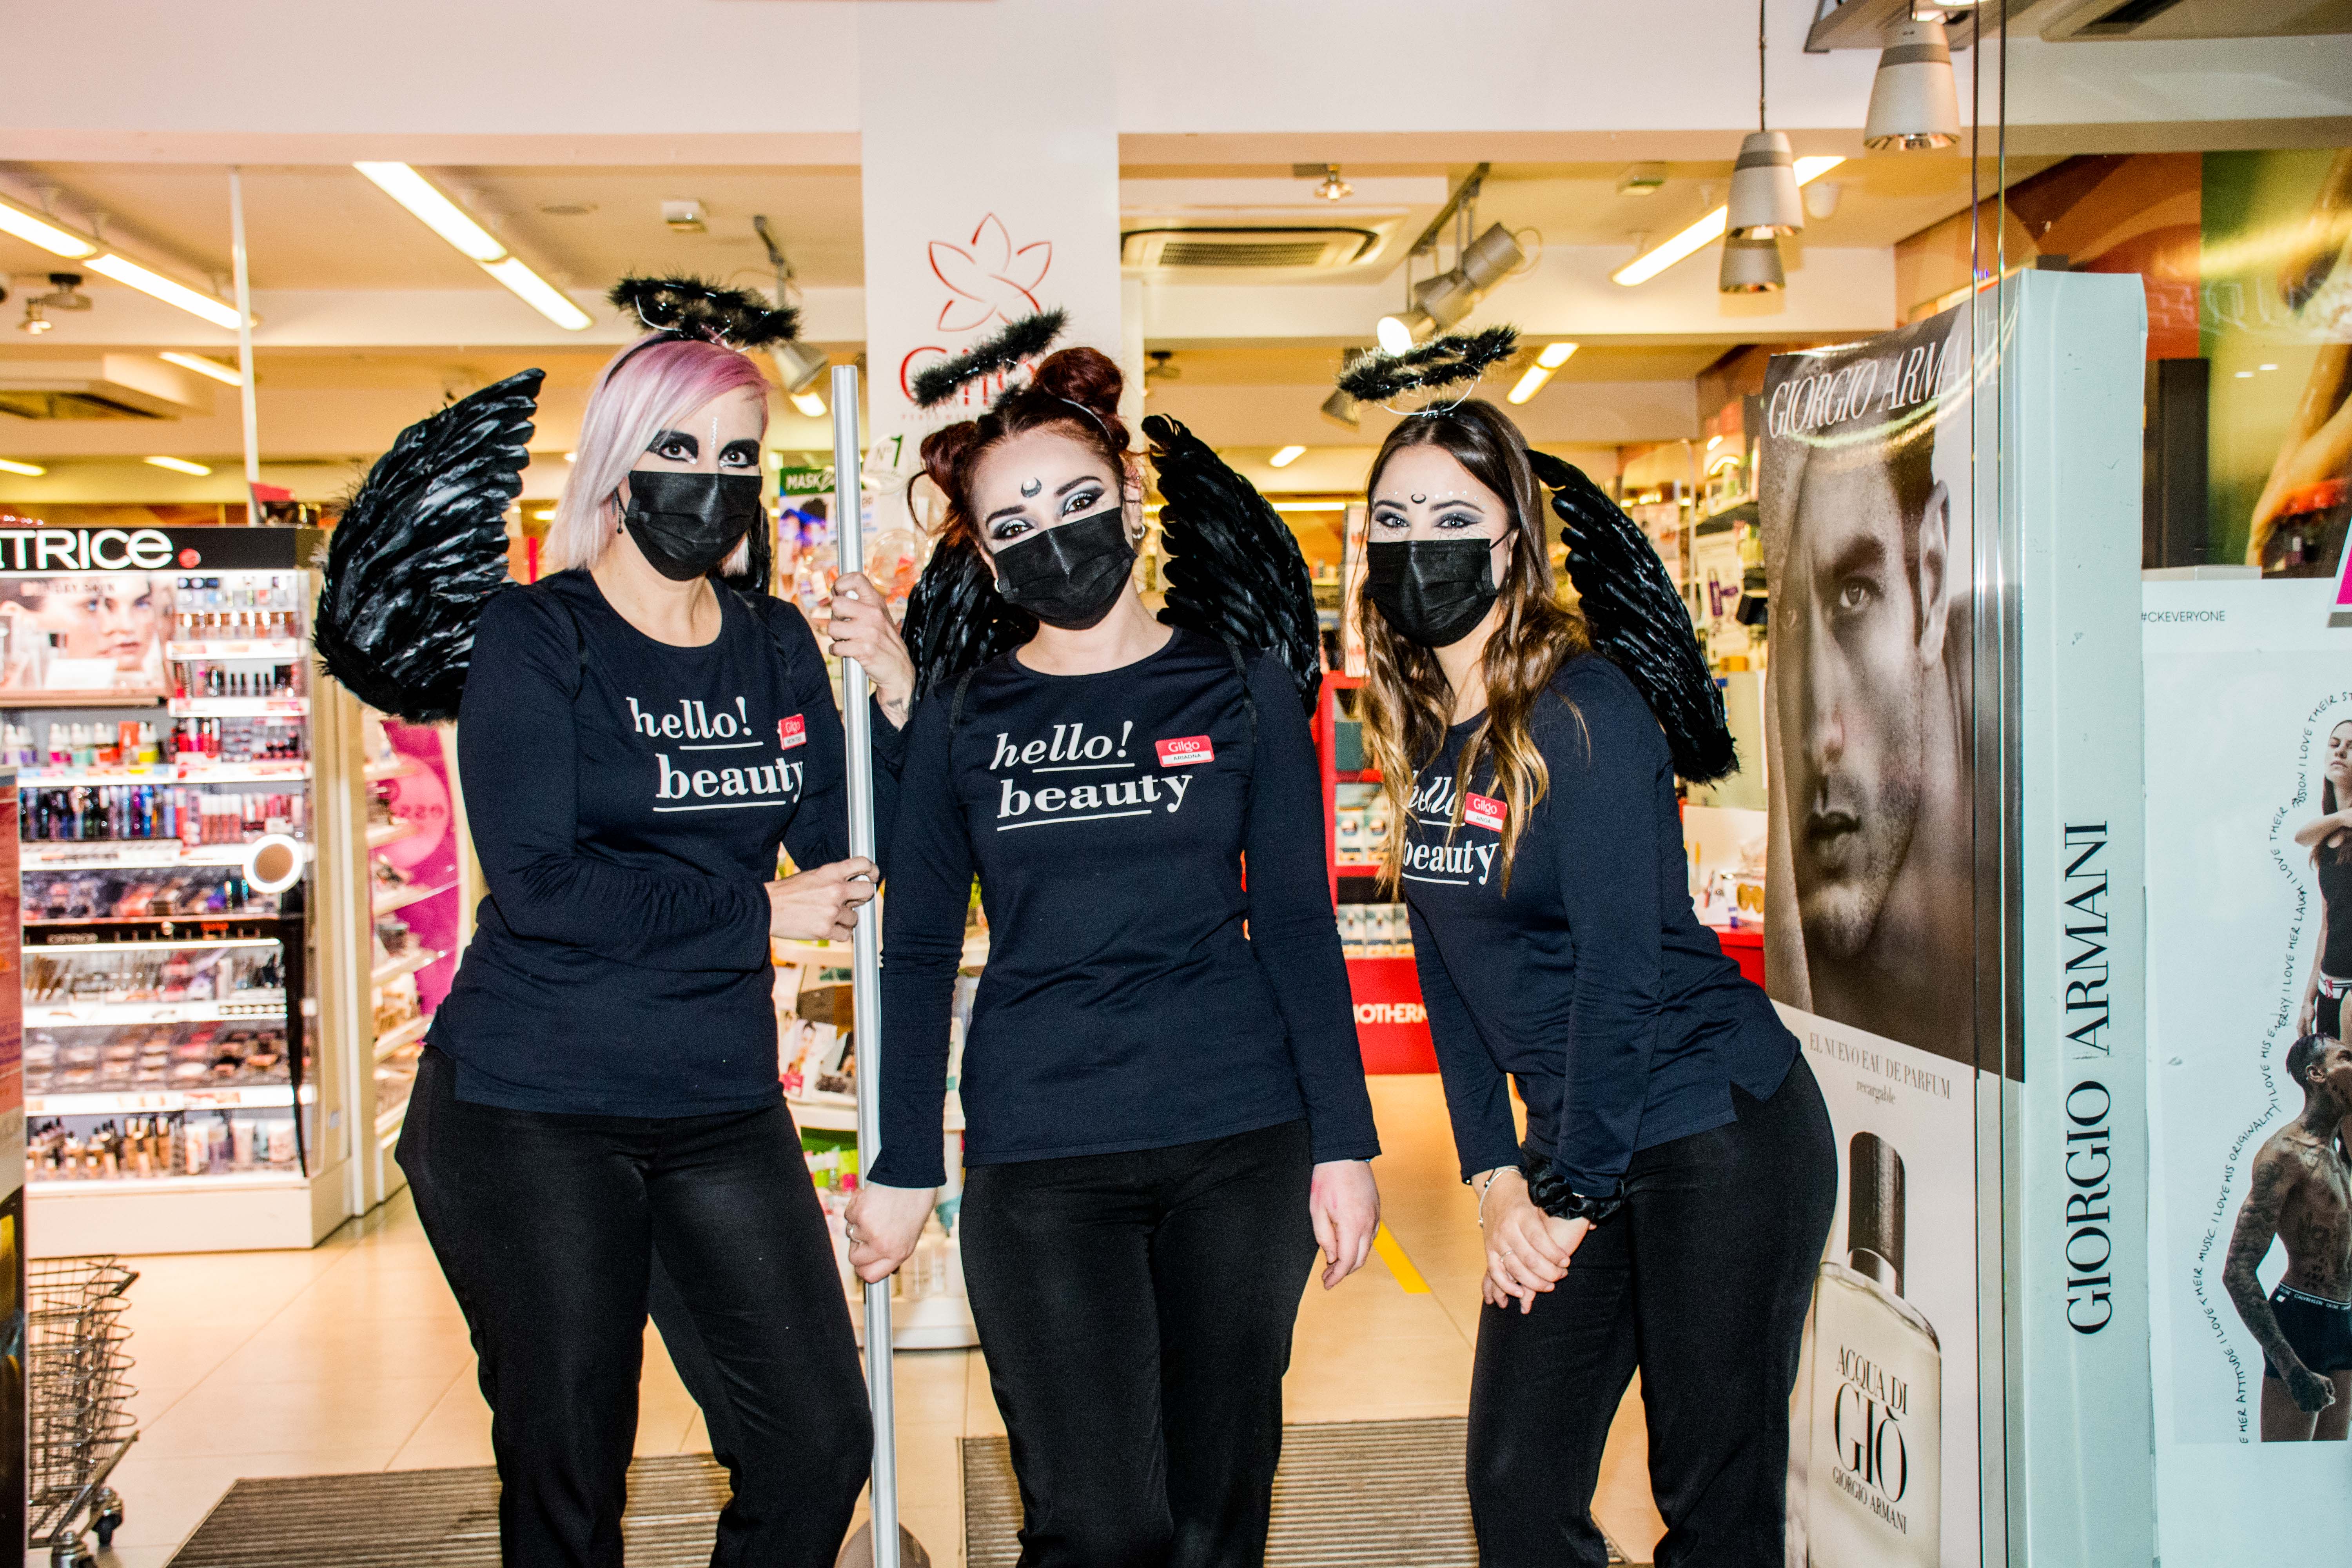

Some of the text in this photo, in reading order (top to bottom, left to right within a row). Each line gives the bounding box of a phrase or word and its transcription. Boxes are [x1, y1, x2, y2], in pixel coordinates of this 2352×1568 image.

[1768, 360, 1878, 439] GIORGIO
[2141, 610, 2225, 622] #CKEVERYONE
[626, 696, 752, 739] hello!
[2308, 695, 2337, 722] THEIR
[990, 720, 1133, 770] hello!
[1168, 740, 1200, 752] Gilgo
[2299, 727, 2312, 759] LOVE
[655, 753, 803, 803] beauty
[997, 775, 1193, 818] beauty
[1473, 798, 1497, 815] Gilgo
[2270, 807, 2288, 841] THEIR
[2270, 849, 2293, 878] LOVE
[2288, 926, 2300, 949] HER
[2283, 953, 2295, 985] LOVE
[2260, 1040, 2271, 1058] HIS
[1809, 1031, 1951, 1100] EL NUEVO EAU DE PARFUM
[2064, 820, 2112, 1334] GIORGIO ARMANI
[2260, 1064, 2276, 1096] LOVE
[1857, 1080, 1896, 1105] recargable
[2224, 1164, 2234, 1182] HIS
[2214, 1185, 2230, 1216] LOVE
[2193, 1267, 2208, 1305] THEIR
[2203, 1307, 2224, 1338] LOVE
[1837, 1344, 1908, 1415] ACQUA DI
[2238, 1408, 2247, 1432] HER
[1832, 1466, 1907, 1534] GIORGIO ARMANI
